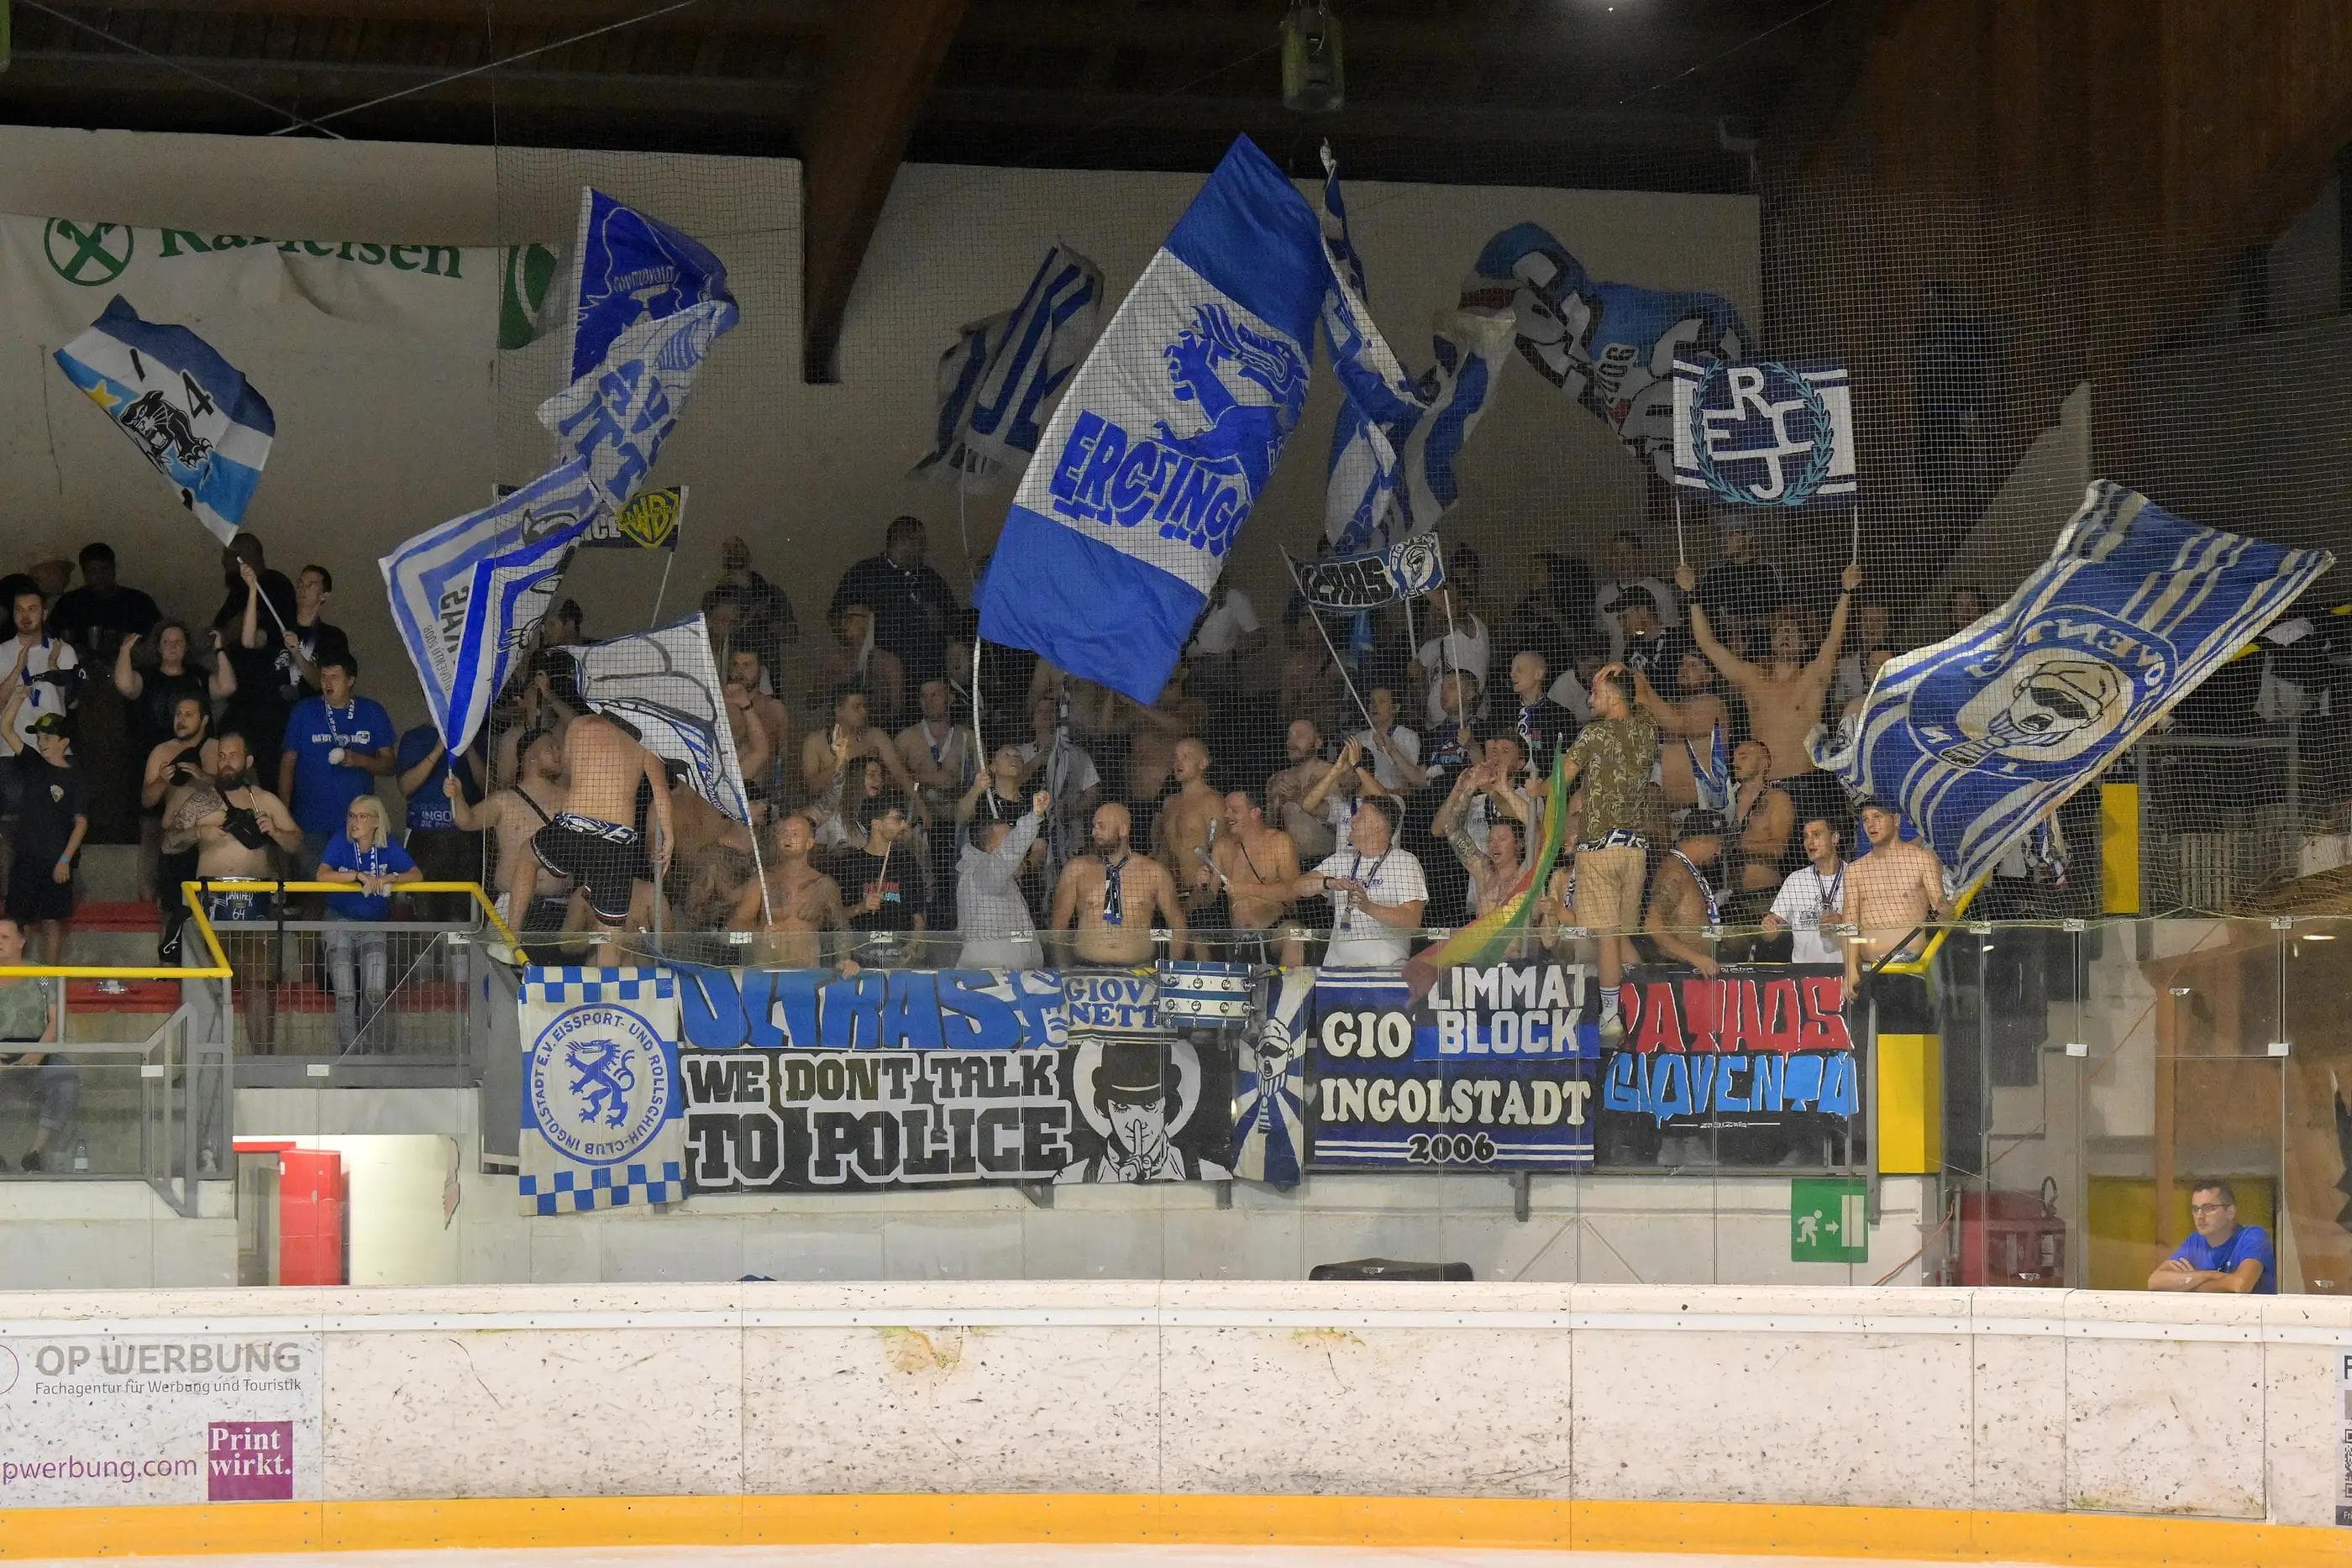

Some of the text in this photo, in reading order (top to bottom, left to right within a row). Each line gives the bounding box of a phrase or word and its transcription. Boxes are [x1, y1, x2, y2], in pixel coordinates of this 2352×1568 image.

[158, 228, 463, 279] Raeisen
[232, 907, 245, 920] 64
[628, 1022, 654, 1051] UND
[1438, 1009, 1582, 1055] BLOCK
[686, 1058, 767, 1104] WE
[930, 1055, 1057, 1099] TALK
[534, 1068, 580, 1151] INGOLSTADT
[1320, 1078, 1592, 1126] INGOLSTADT
[688, 1106, 1068, 1183] TO POLICE
[1407, 1132, 1496, 1164] 2006
[36, 1342, 301, 1377] OP WERBUNG
[35, 1377, 302, 1398] Fachagentur für Werbung und Touristik
[209, 1426, 281, 1451] Print
[209, 1452, 292, 1476] wirkt.
